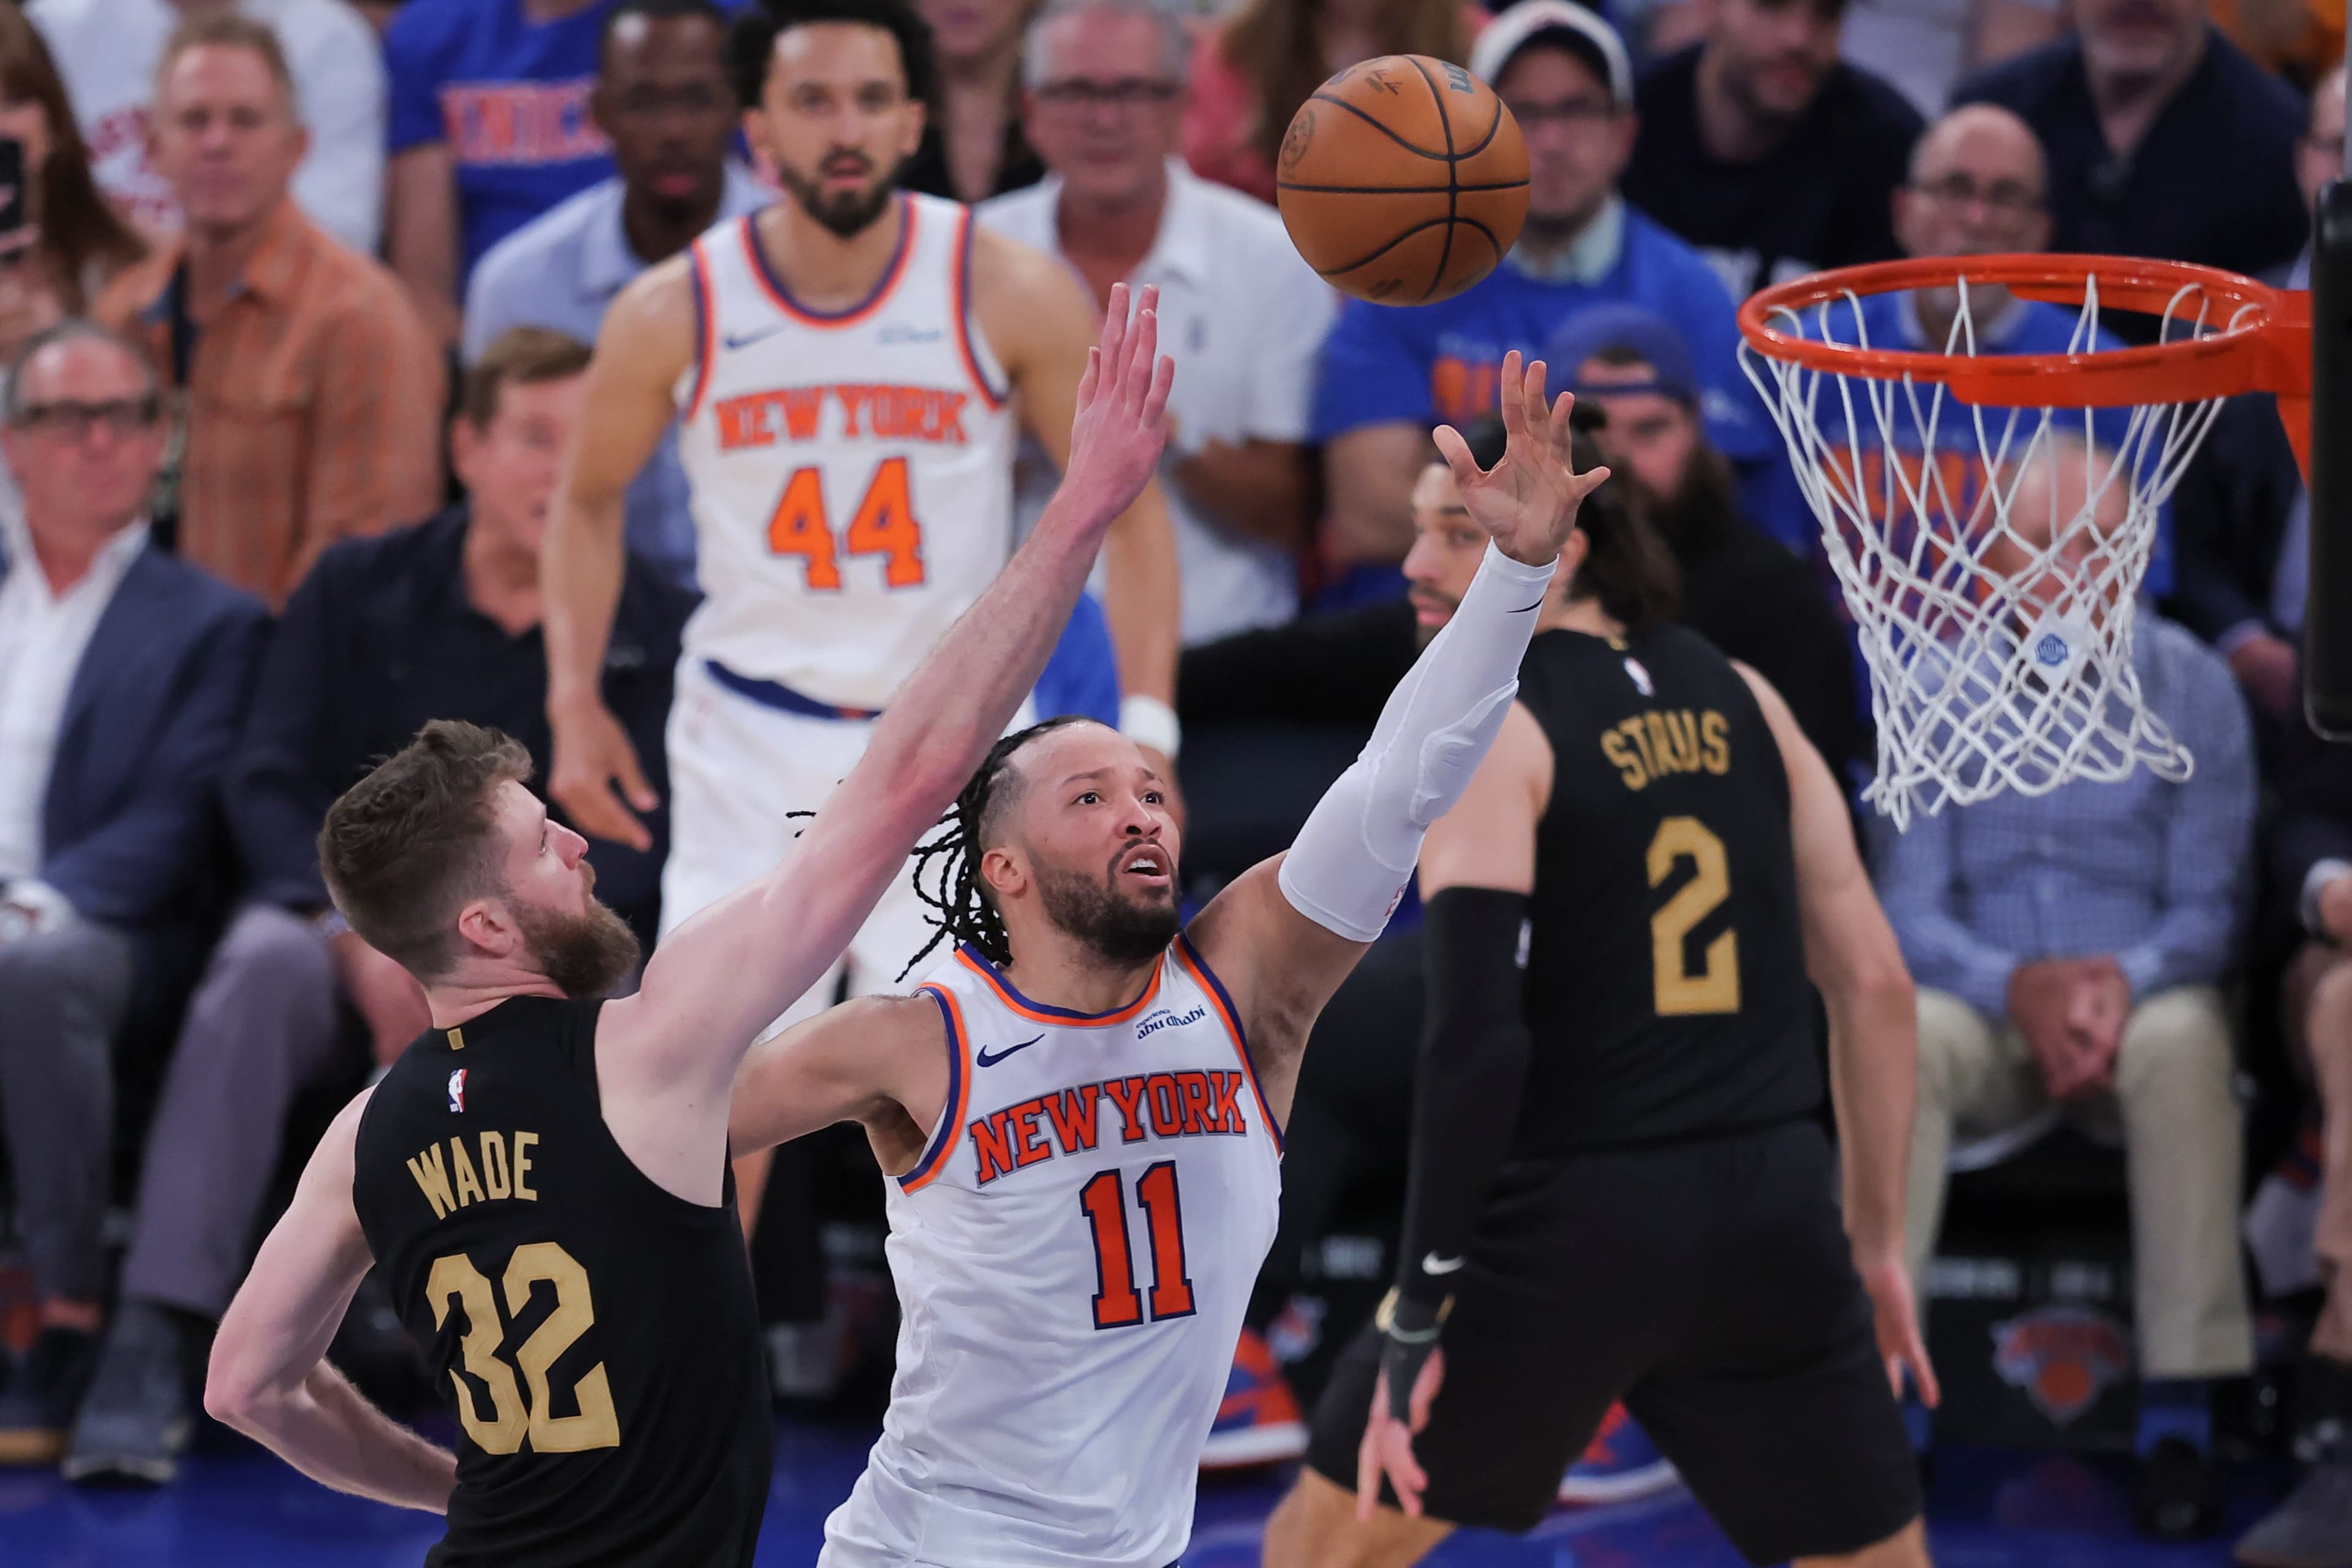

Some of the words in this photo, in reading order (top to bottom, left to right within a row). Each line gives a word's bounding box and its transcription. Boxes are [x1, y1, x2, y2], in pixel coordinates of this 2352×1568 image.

[714, 385, 824, 452] NEW
[834, 383, 969, 447] YORK
[766, 456, 925, 590] 44
[1600, 709, 1730, 791] STRUS
[1646, 815, 1741, 1017] 2
[1137, 1019, 1165, 1040] abu
[1166, 1004, 1206, 1027] dhabi
[406, 1130, 540, 1221] WADE
[968, 1084, 1101, 1188] NEW
[1102, 1069, 1247, 1145] YORK
[1079, 1159, 1197, 1330] 11
[426, 1241, 620, 1455] 32
